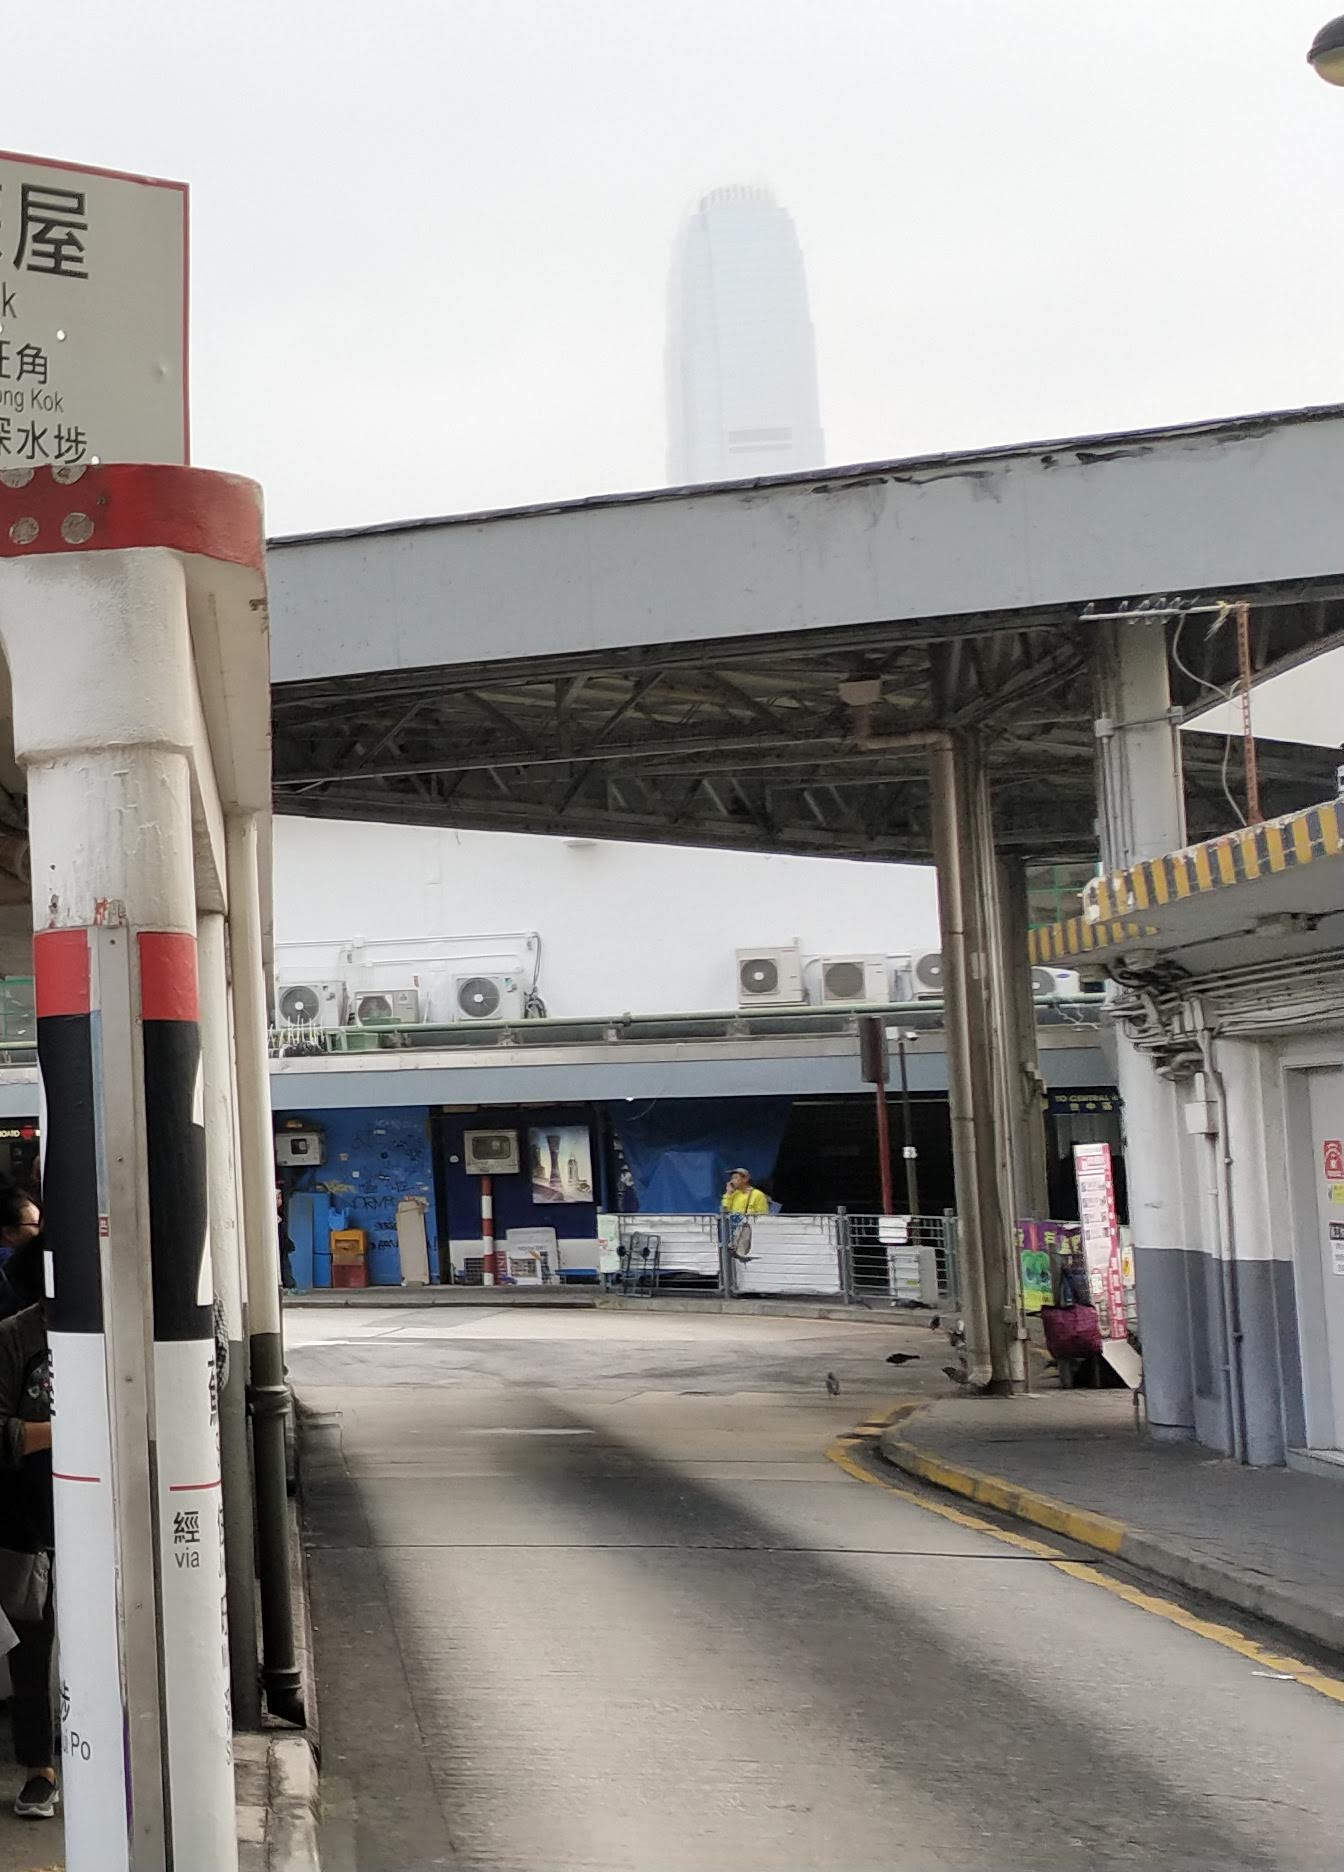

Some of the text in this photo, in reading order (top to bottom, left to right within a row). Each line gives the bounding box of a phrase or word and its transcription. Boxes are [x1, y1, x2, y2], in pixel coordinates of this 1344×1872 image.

[31, 393, 64, 413] Kok
[173, 1510, 200, 1544] 經
[175, 1547, 201, 1569] via
[71, 1731, 91, 1760] Po
